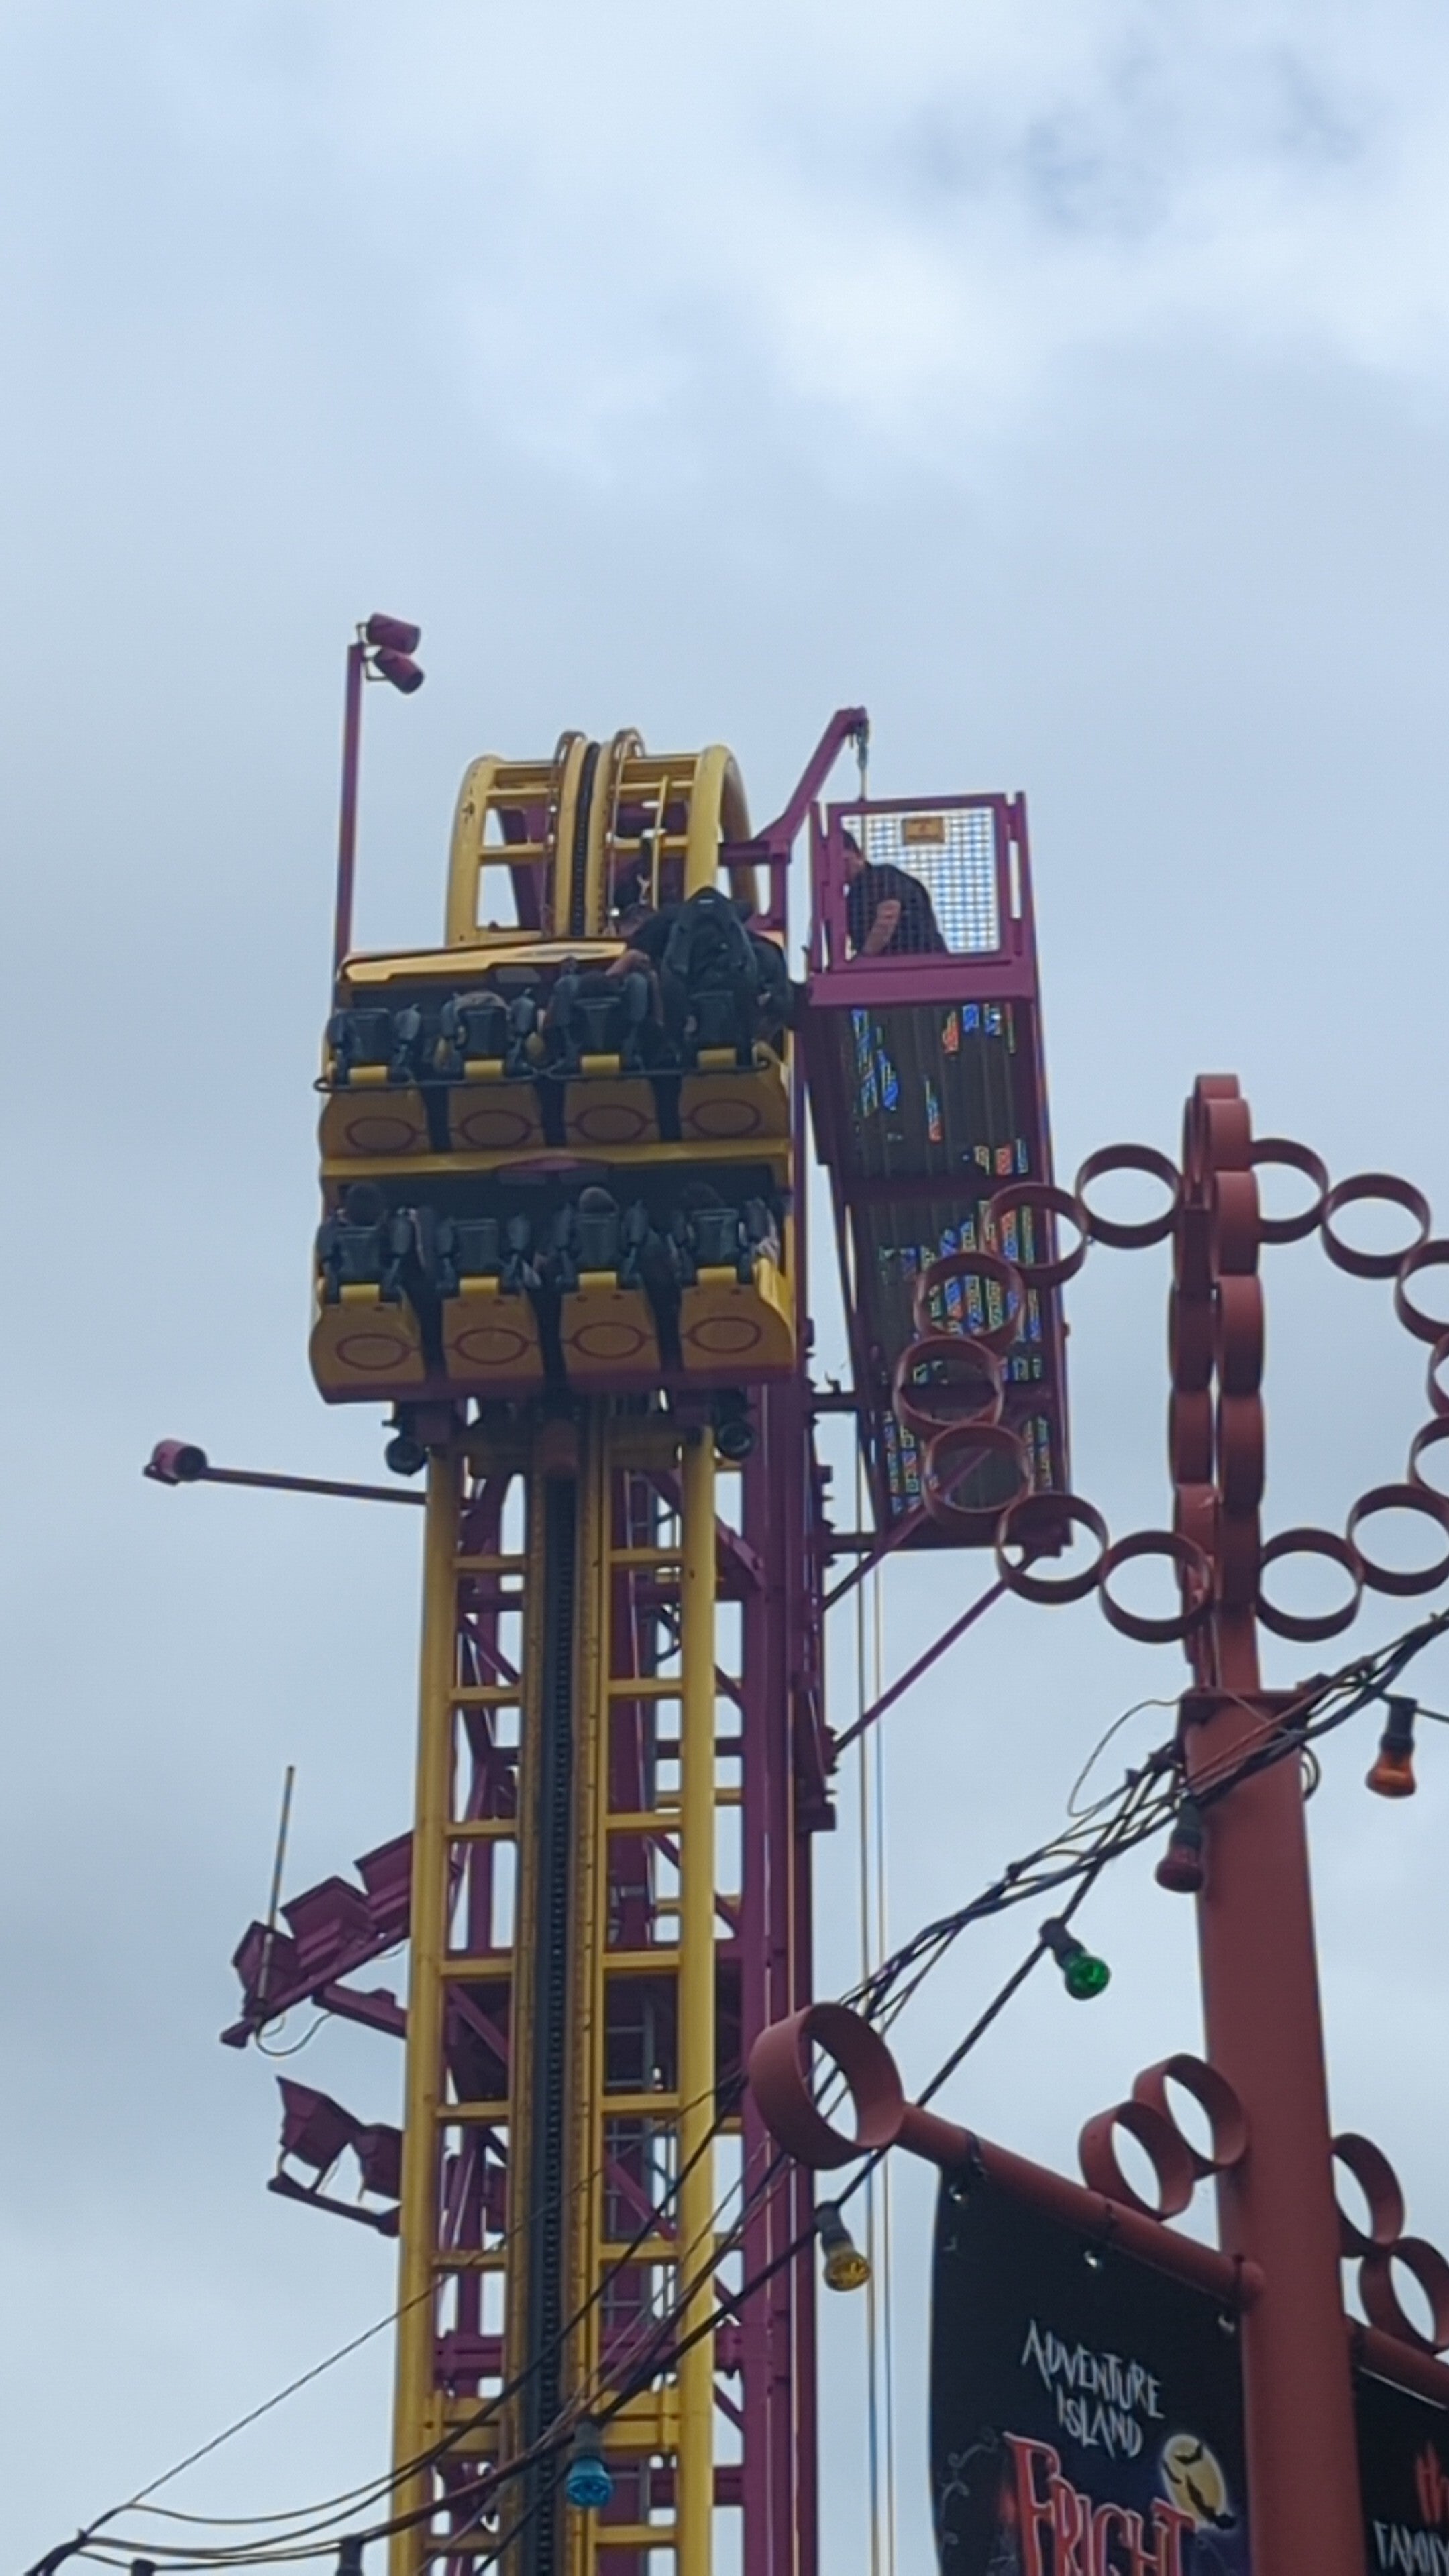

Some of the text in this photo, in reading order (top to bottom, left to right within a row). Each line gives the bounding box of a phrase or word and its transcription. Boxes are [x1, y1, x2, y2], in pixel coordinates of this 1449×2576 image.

[1020, 2318, 1166, 2419] ADVENTURE
[1056, 2383, 1143, 2459] ISLAND
[1003, 2430, 1198, 2576] FRIGHT
